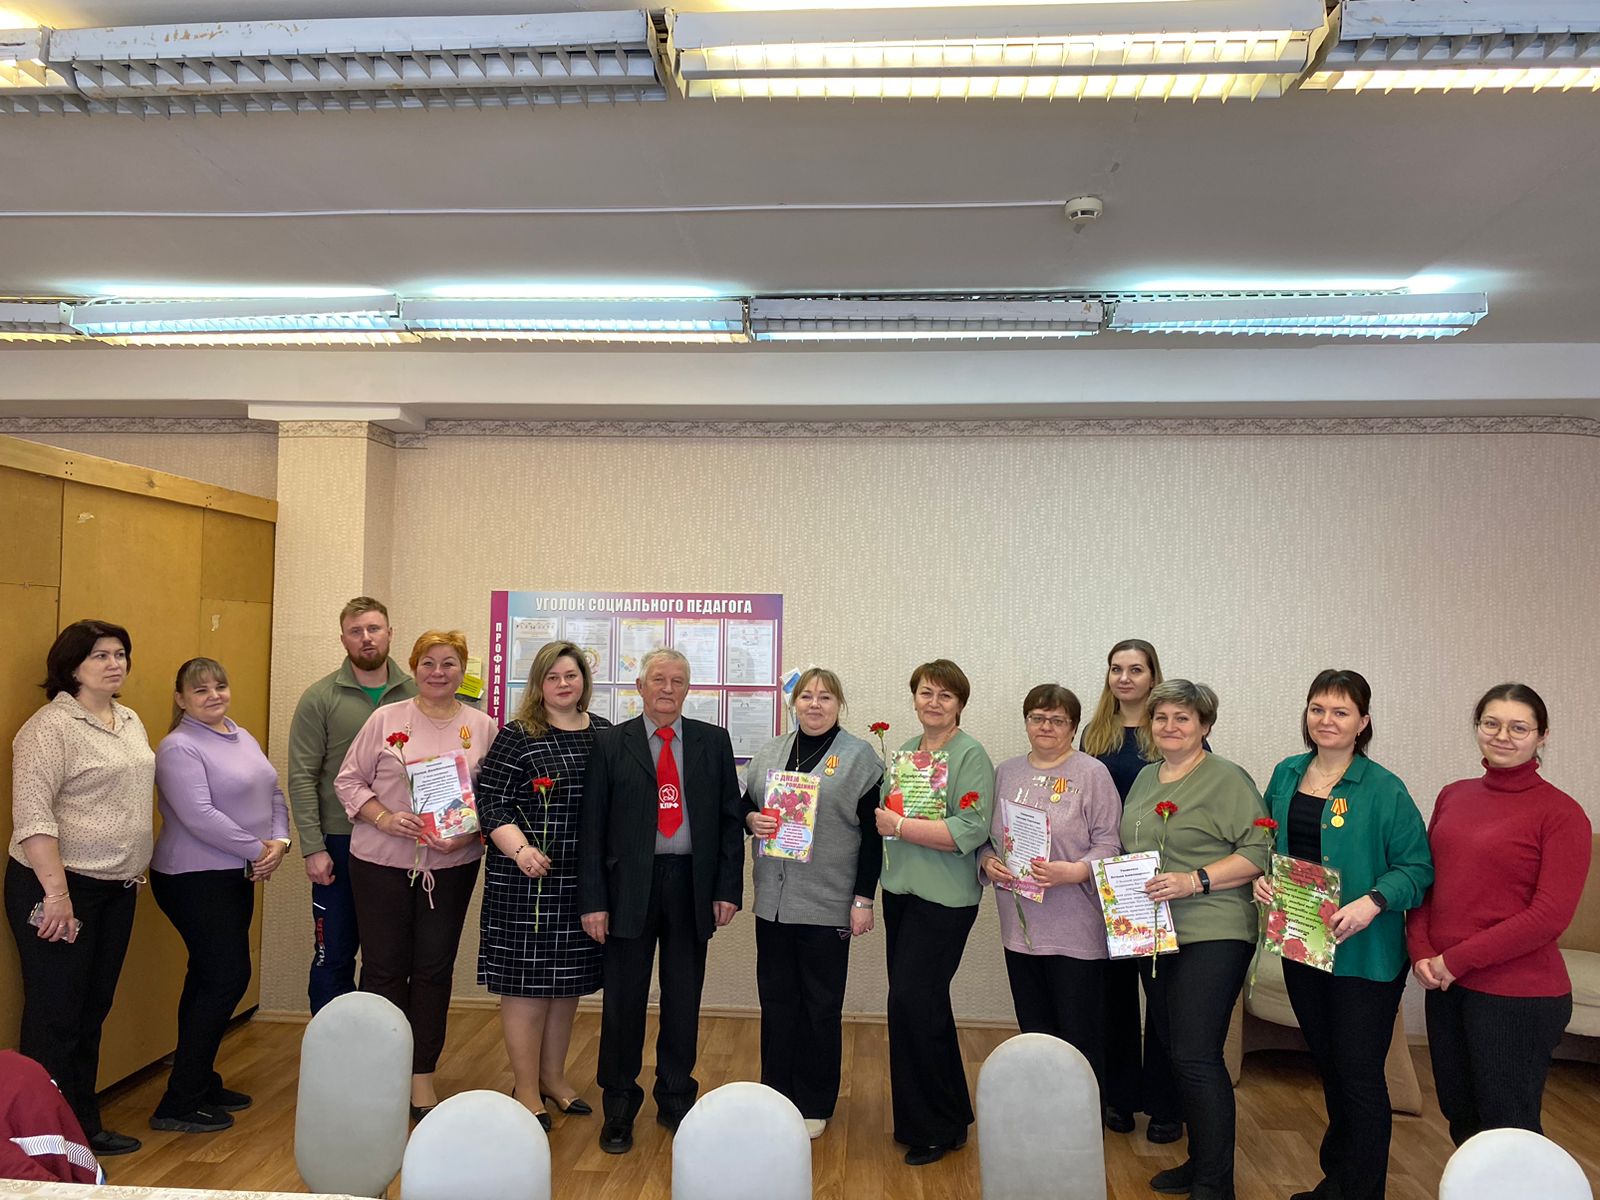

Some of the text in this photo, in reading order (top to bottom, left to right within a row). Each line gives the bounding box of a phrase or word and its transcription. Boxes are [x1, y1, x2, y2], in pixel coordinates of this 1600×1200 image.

[536, 597, 752, 614] УГОЛОК СОЦИАЛЬНОГО ПЕДАГОГА
